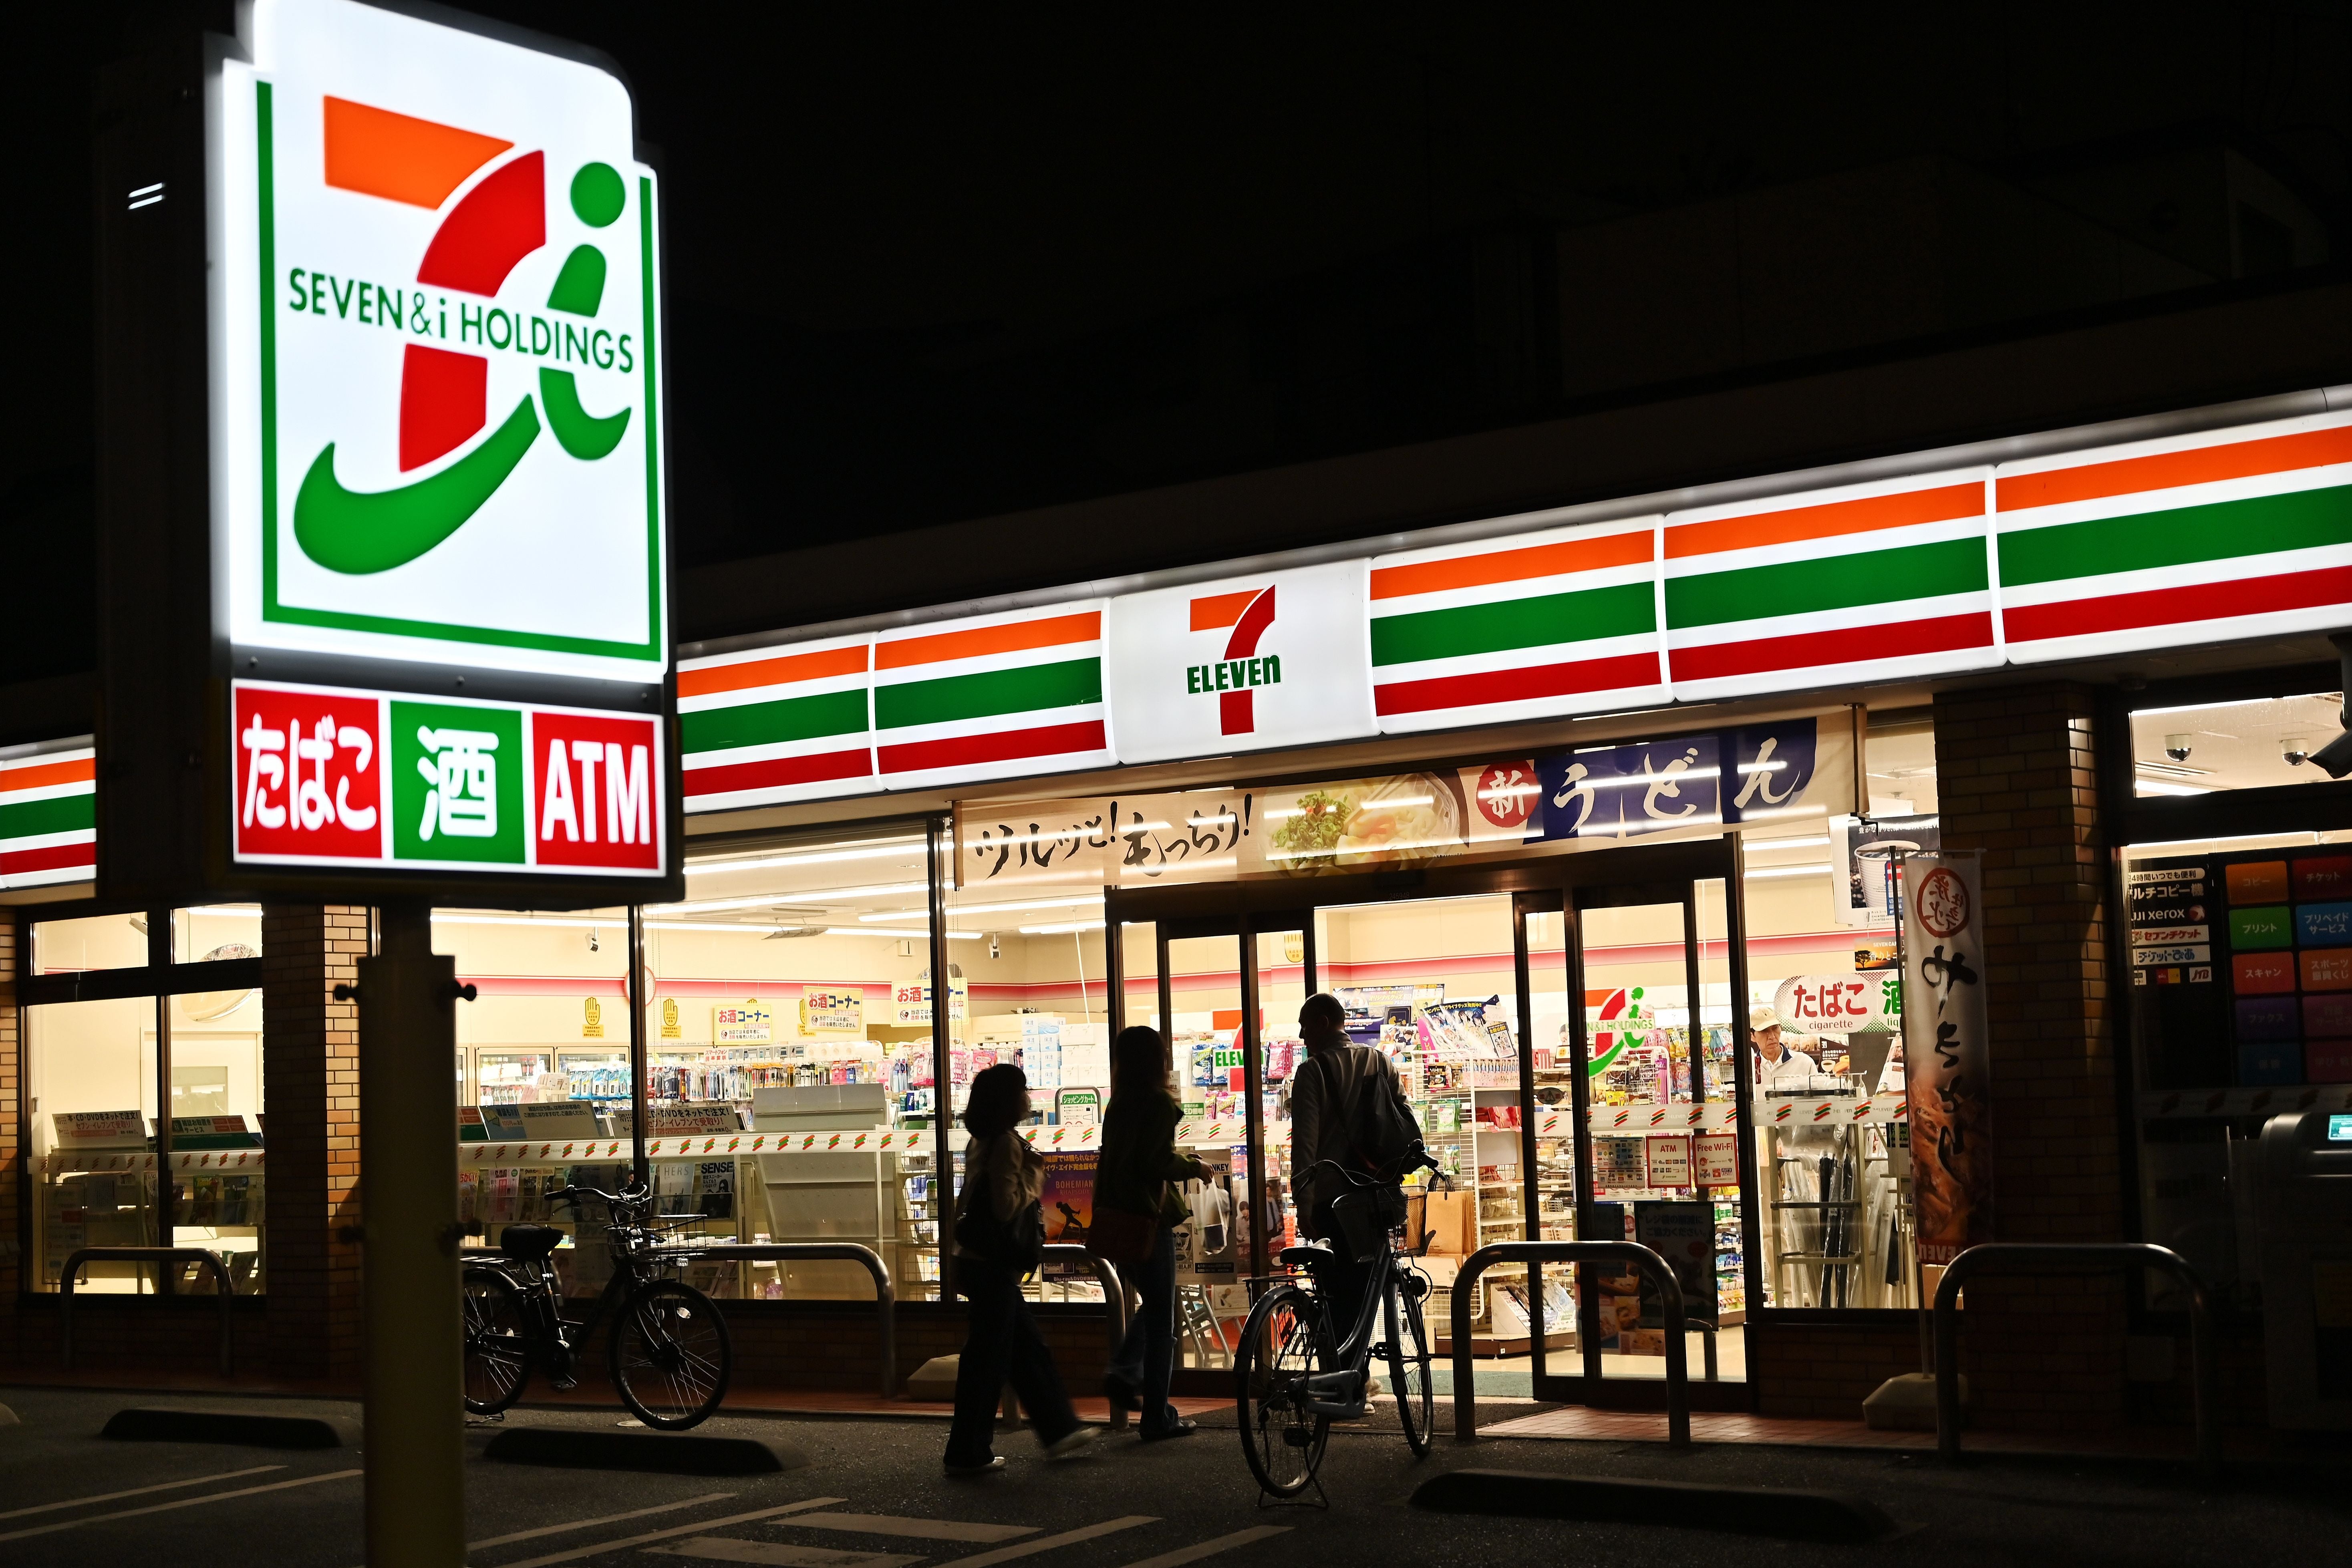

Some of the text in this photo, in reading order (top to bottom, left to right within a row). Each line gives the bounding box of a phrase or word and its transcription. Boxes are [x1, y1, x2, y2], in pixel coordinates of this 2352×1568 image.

[461, 296, 634, 376] HOLDINGS
[242, 713, 378, 835] たばこ
[417, 723, 499, 842] 酒
[1553, 737, 1800, 834] うどん
[541, 738, 652, 846] ATM
[1487, 770, 1530, 819] 新
[2131, 870, 2196, 882] 4時間いつでも便利
[2306, 871, 2341, 883] チケット
[2243, 877, 2270, 888] コピー
[2148, 908, 2186, 920] xerox
[2304, 912, 2350, 924] プリペイド
[2242, 923, 2277, 934] プリント
[2308, 923, 2347, 935] サービス
[2144, 929, 2201, 941] セブンチケット
[2138, 948, 2195, 963] チケットぴあ
[2311, 958, 2349, 970] スポーツ
[2191, 969, 2210, 981] JTB
[2245, 967, 2282, 979] スキャン
[809, 992, 860, 1010] お酒コーナー
[1794, 981, 1867, 1018] たばこ
[719, 1009, 769, 1024] お酒コーナー
[1607, 1020, 1653, 1031] HOLDINGS
[1809, 1020, 1853, 1031] cigarette
[1063, 1095, 1094, 1104] ショッピングカート
[1660, 1145, 1677, 1153] ATM
[1697, 1142, 1733, 1152] Free Wi-Fi
[664, 1165, 689, 1176] HERS
[701, 1161, 733, 1174] SENSE
[1212, 1163, 1229, 1172] NKEY
[1055, 1180, 1093, 1189] BOHEMIAN
